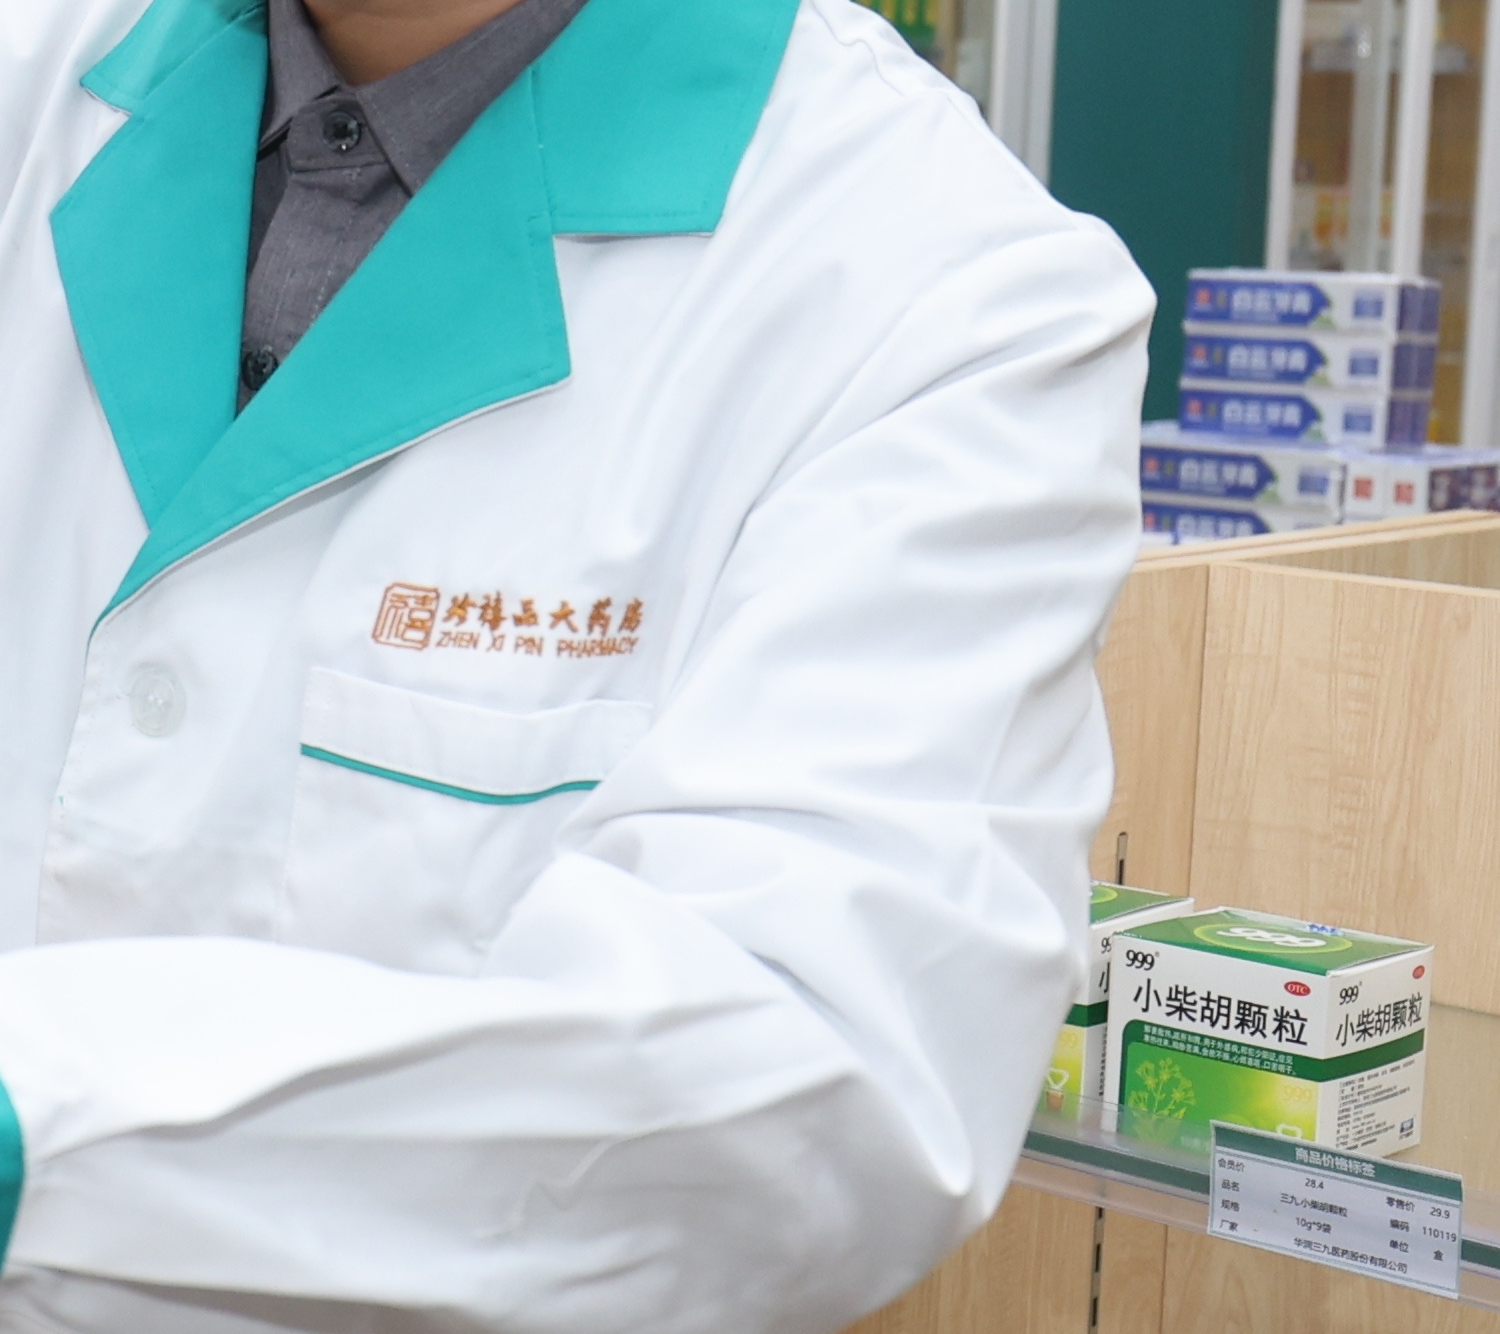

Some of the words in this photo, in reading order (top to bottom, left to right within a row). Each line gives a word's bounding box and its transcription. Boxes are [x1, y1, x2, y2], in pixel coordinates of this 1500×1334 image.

[435, 631, 479, 650] ZHEN
[514, 635, 543, 657] PIN
[1216, 926, 1327, 948] 999
[1125, 949, 1156, 972] 999
[1287, 983, 1309, 995] OTC
[1339, 985, 1359, 1007] 999
[1133, 978, 1309, 1047] 小柴胡颗粒
[1335, 991, 1423, 1048] 小柴胡颗粒
[1217, 1157, 1245, 1173] 会员价
[1294, 1147, 1377, 1178] 商品价格标签
[1221, 1179, 1241, 1193] 品名
[1304, 1178, 1325, 1191] 28.4
[1220, 1198, 1240, 1213] 规格
[1385, 1196, 1416, 1213] 零售价
[1430, 1205, 1451, 1219] 29.9
[1219, 1219, 1239, 1233] 厂家
[1389, 1218, 1410, 1233] 编码
[1422, 1225, 1458, 1243] 110119
[1389, 1239, 1410, 1253] 单位
[1293, 1237, 1408, 1274] 华润三九医药股份有限公司
